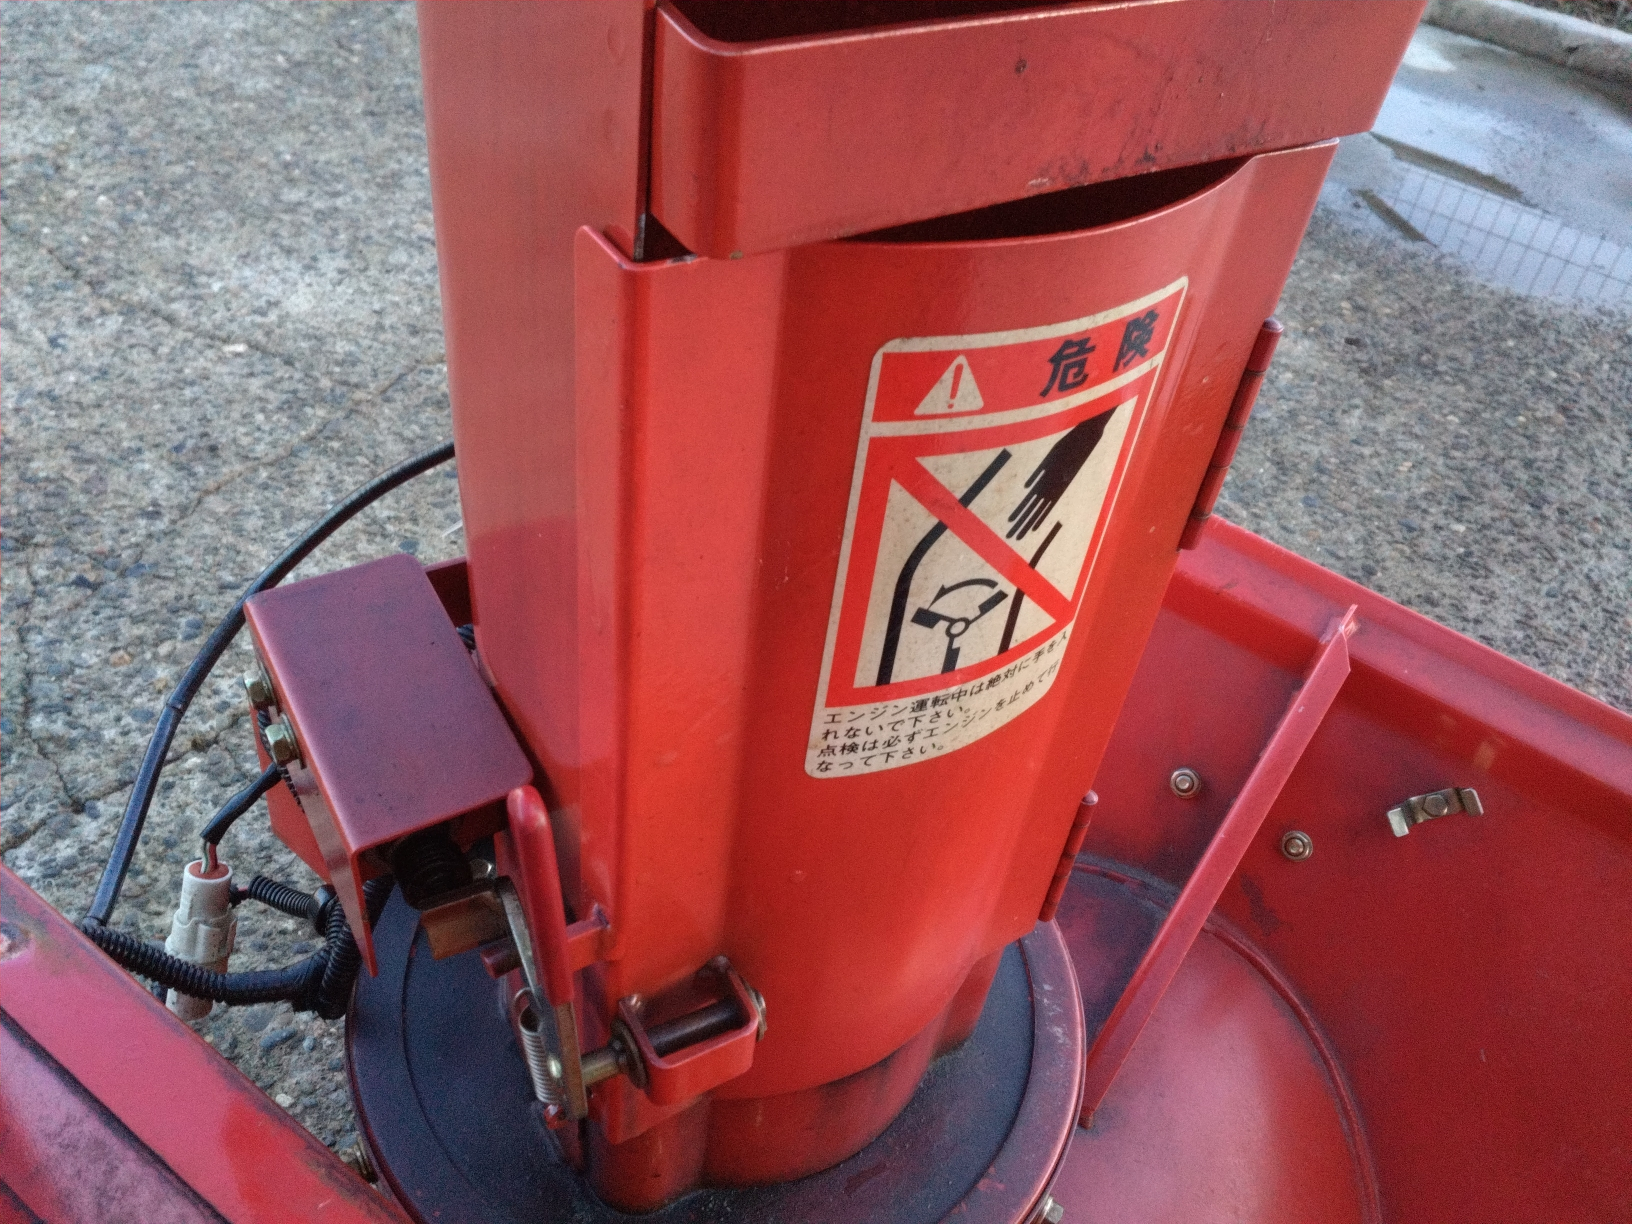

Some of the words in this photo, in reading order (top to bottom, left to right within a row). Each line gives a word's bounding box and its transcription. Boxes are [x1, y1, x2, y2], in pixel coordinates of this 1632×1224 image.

[1039, 309, 1159, 397] 危険
[822, 706, 970, 742] れないで下さい。
[817, 744, 944, 772] なって下さい。
